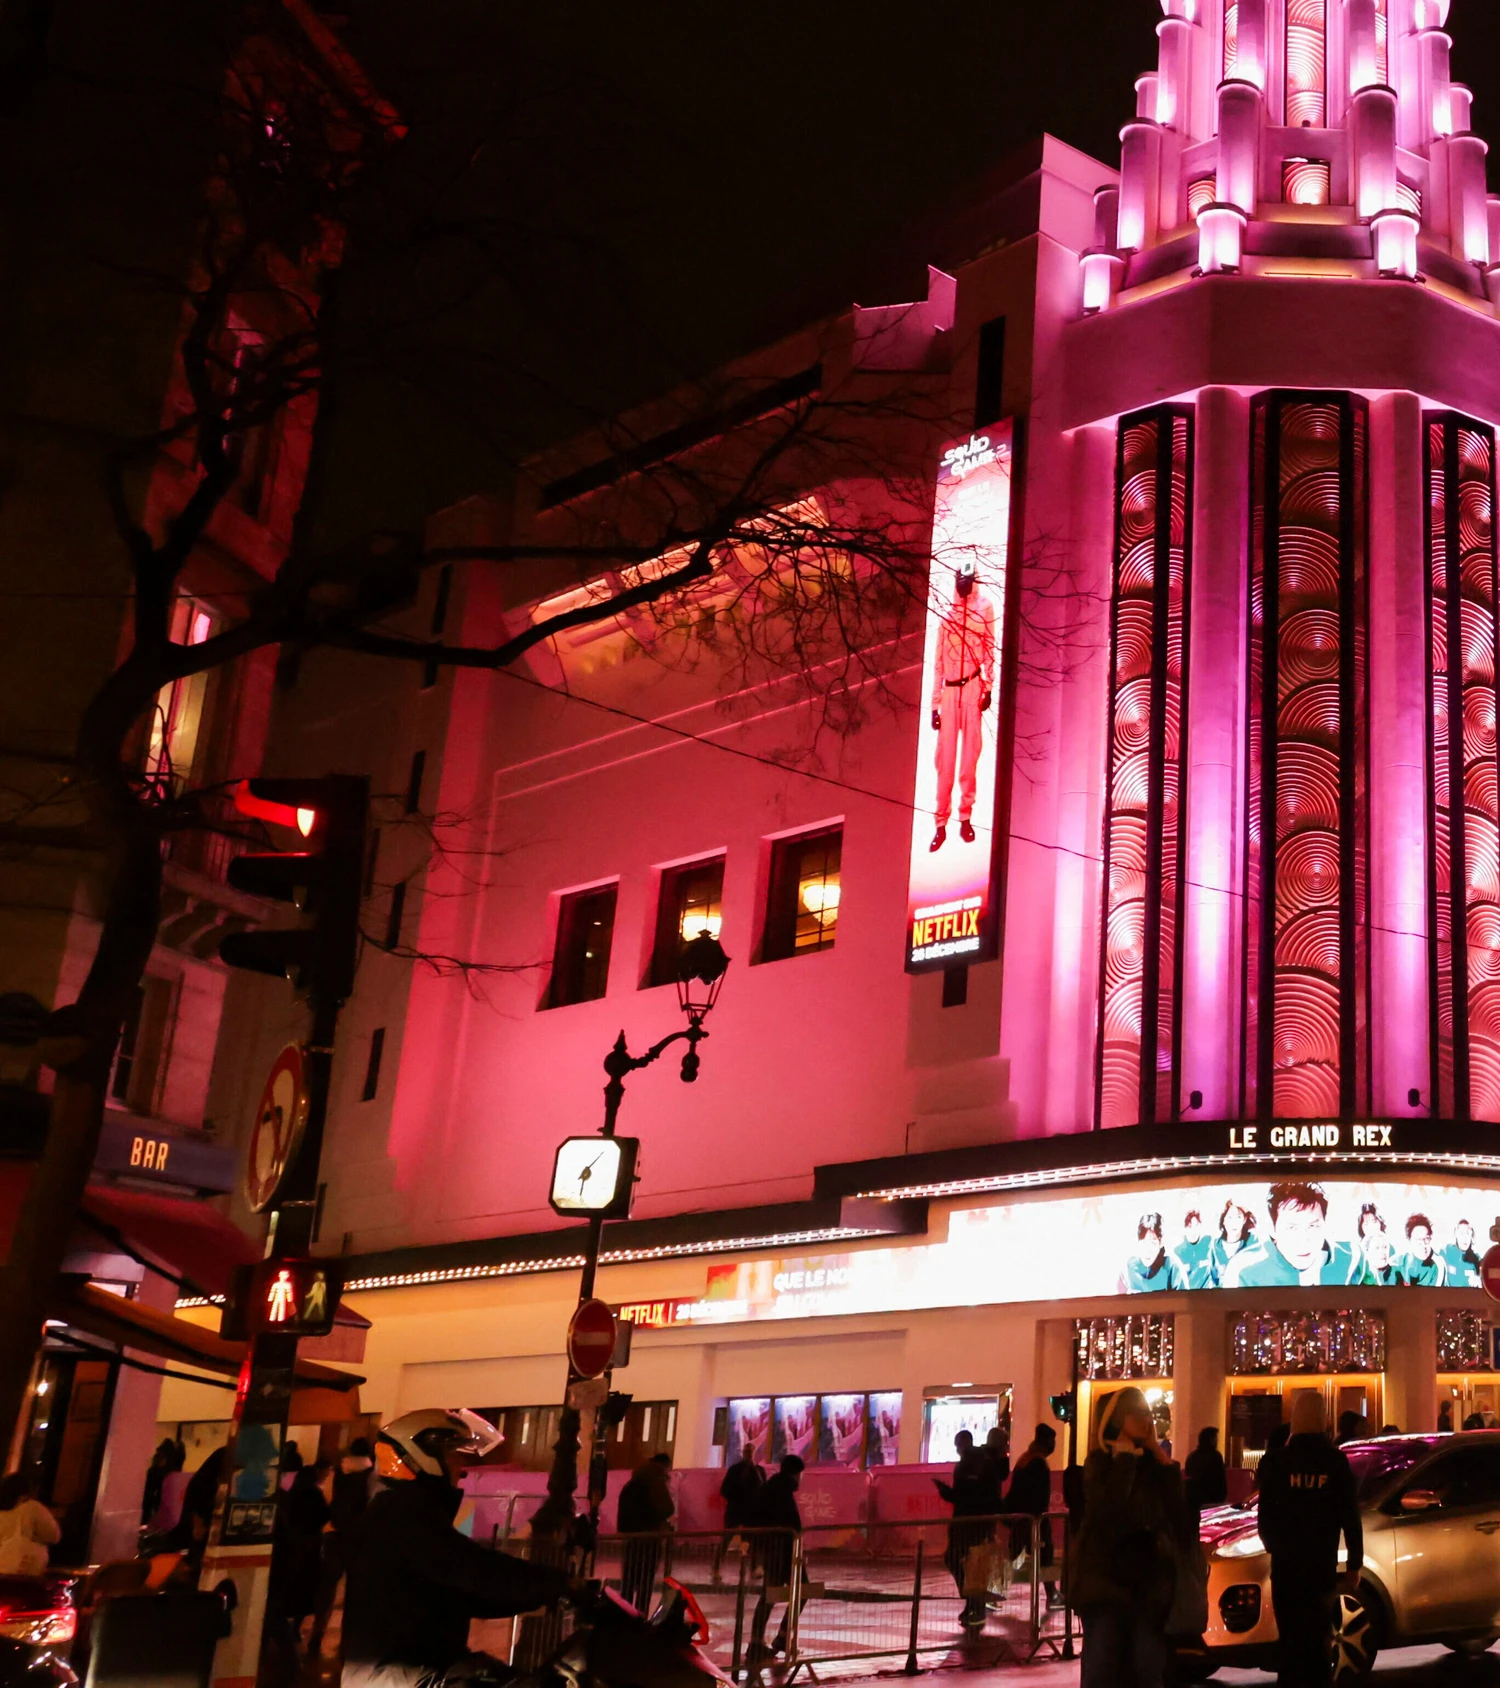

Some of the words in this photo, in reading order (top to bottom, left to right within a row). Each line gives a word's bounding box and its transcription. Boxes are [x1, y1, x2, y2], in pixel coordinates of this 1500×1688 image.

[912, 909, 980, 949] NETFLIX
[1230, 1127, 1257, 1149] LE
[1270, 1125, 1340, 1147] GRAND
[1352, 1124, 1393, 1147] REX
[130, 1136, 169, 1171] BAR
[773, 1272, 804, 1293] QUE
[619, 1302, 666, 1325] NETFLIX
[1290, 1473, 1328, 1489] HUF
